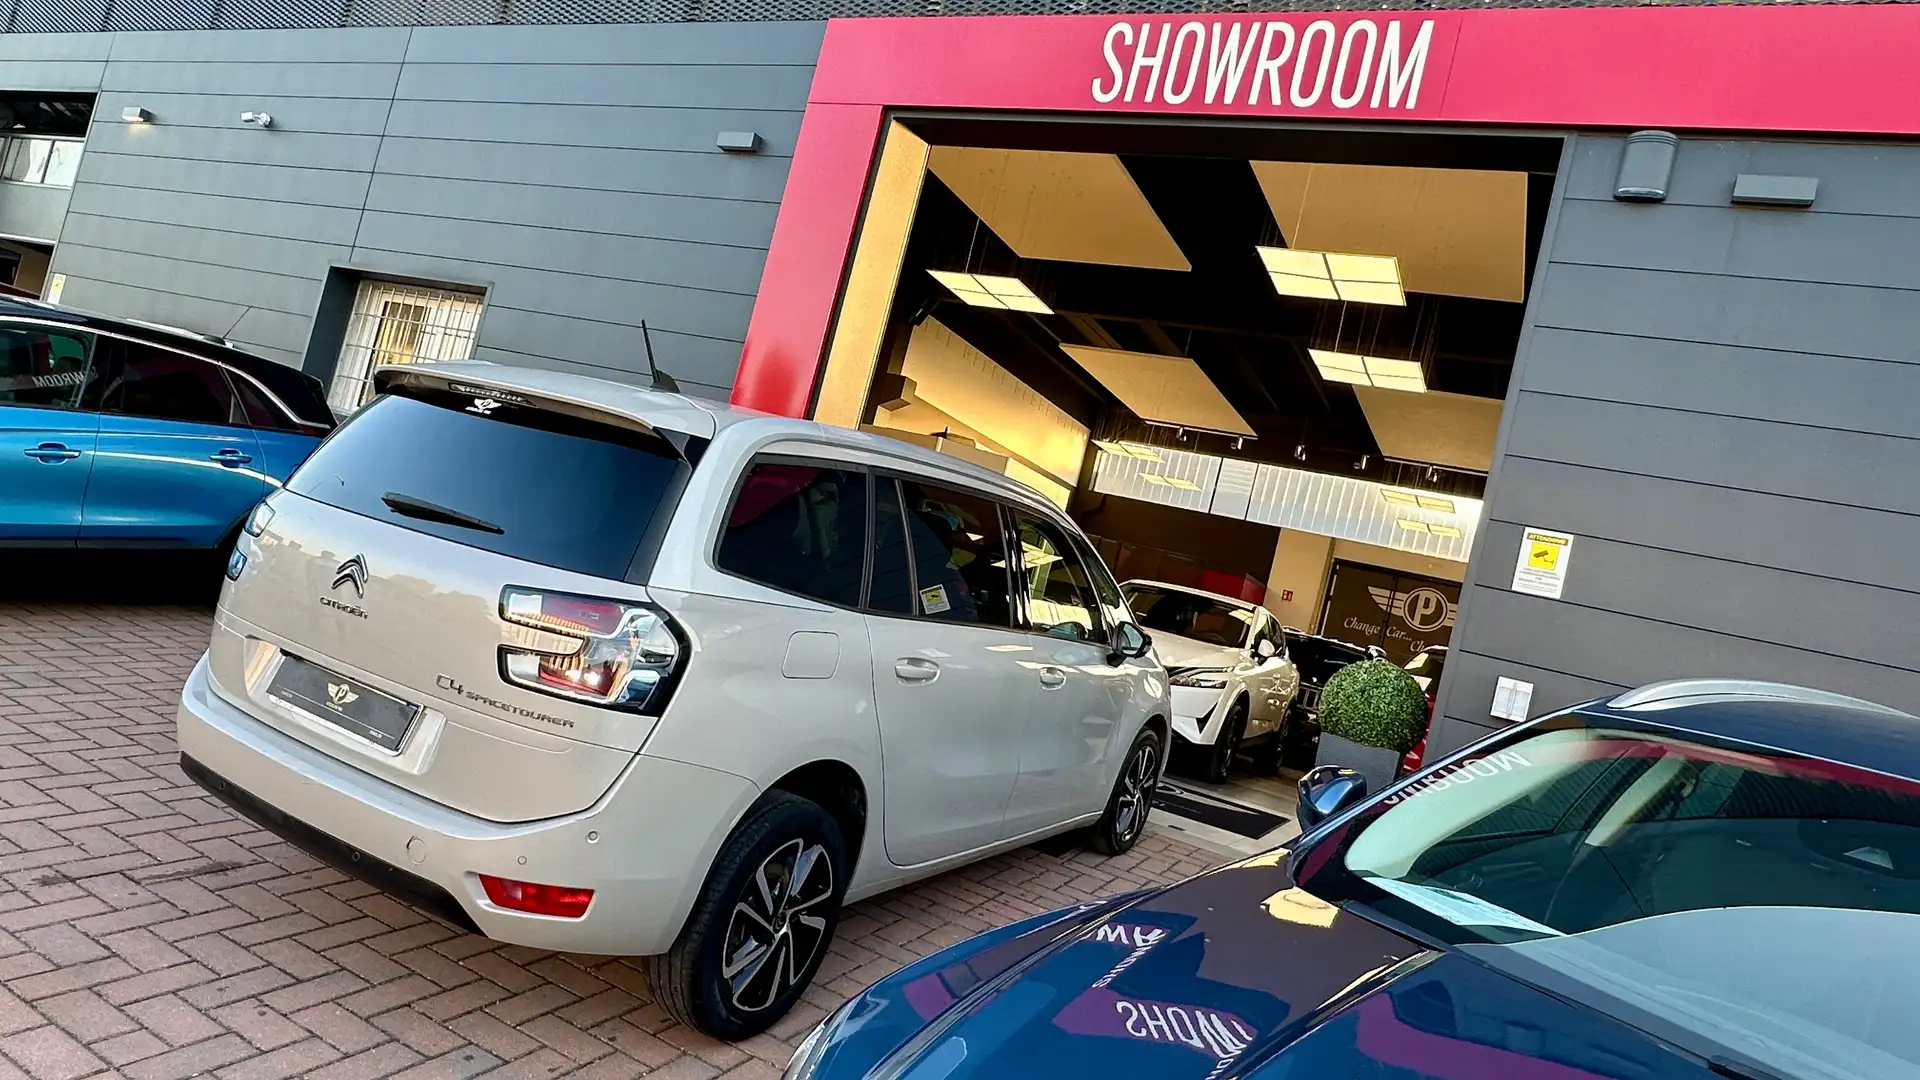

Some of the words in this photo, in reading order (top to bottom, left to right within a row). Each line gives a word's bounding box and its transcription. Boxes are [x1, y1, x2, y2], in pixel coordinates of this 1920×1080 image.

[1092, 19, 1435, 110] SHOWROOM
[1344, 617, 1380, 636] Change
[1413, 590, 1438, 625] P
[436, 673, 464, 695] C4
[466, 691, 575, 728] SPACETOURER
